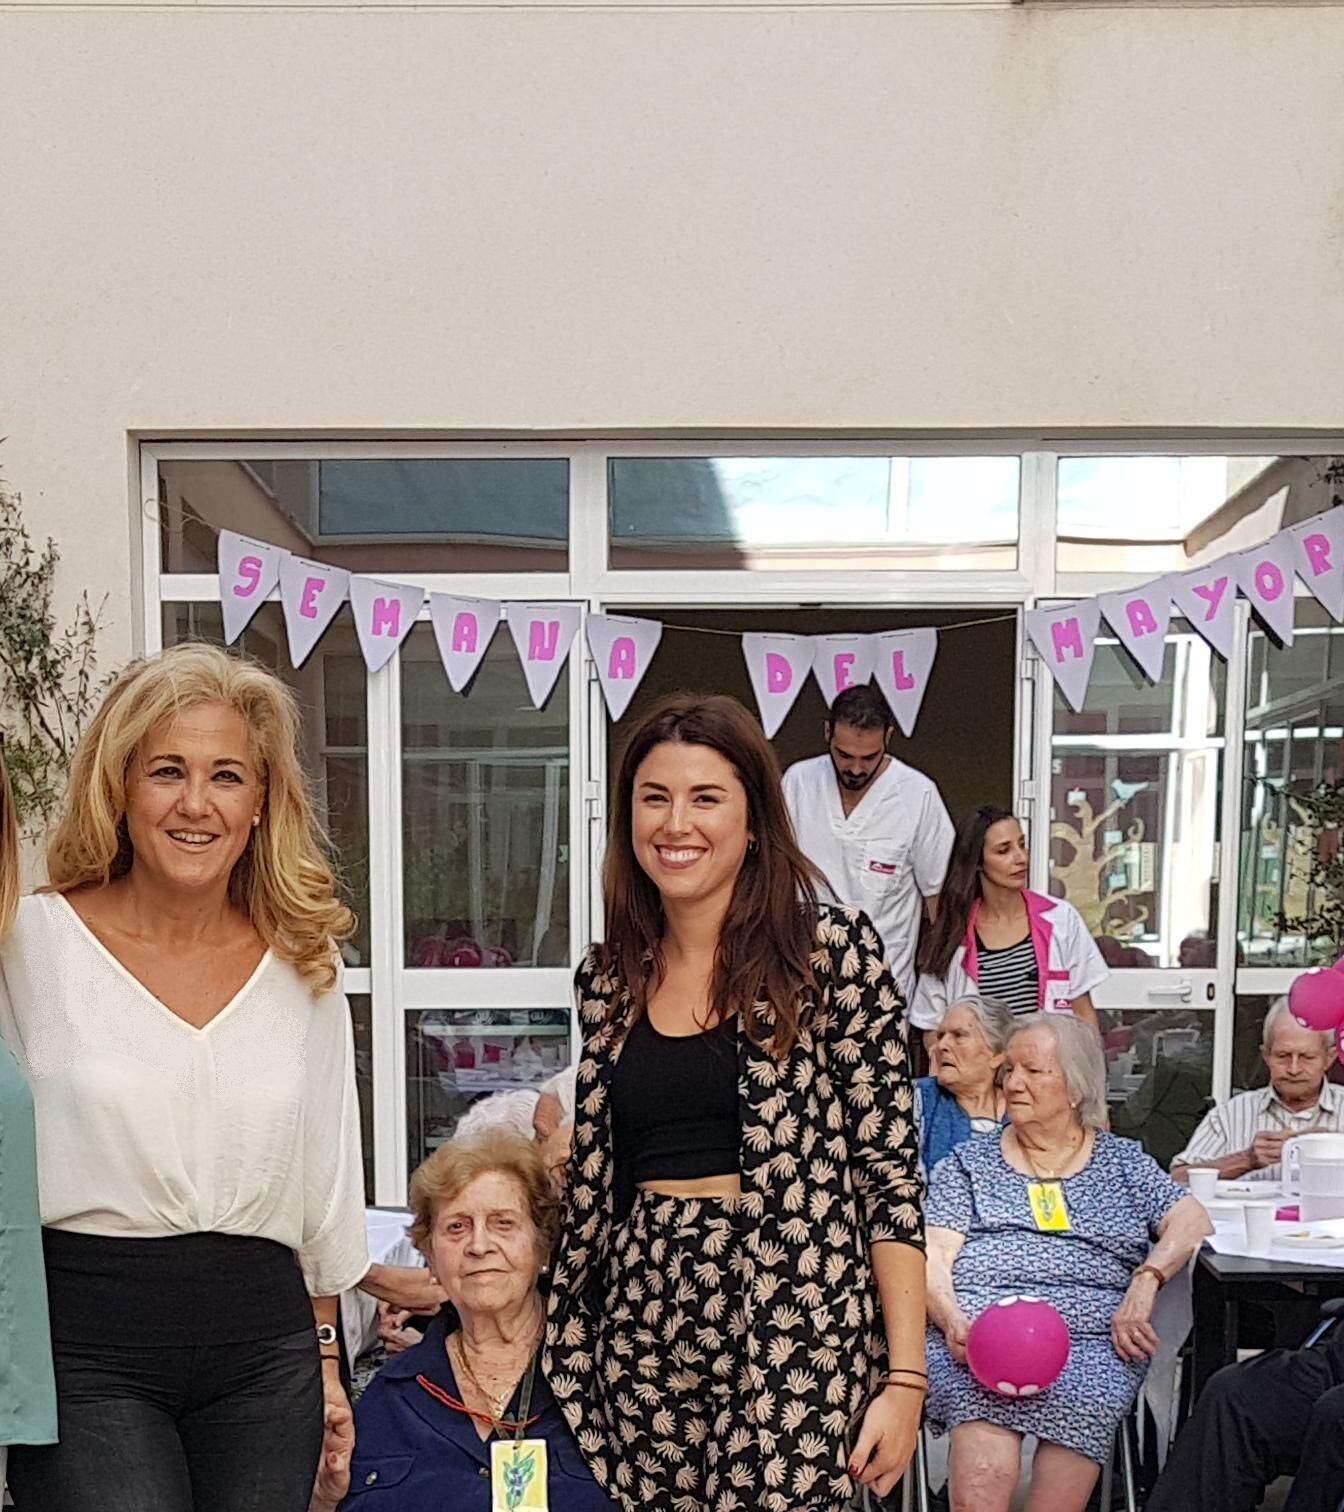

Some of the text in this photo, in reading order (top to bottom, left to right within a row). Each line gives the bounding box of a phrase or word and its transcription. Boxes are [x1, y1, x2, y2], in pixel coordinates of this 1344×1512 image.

[233, 533, 1333, 693] SEMANA DEL MAYOR
